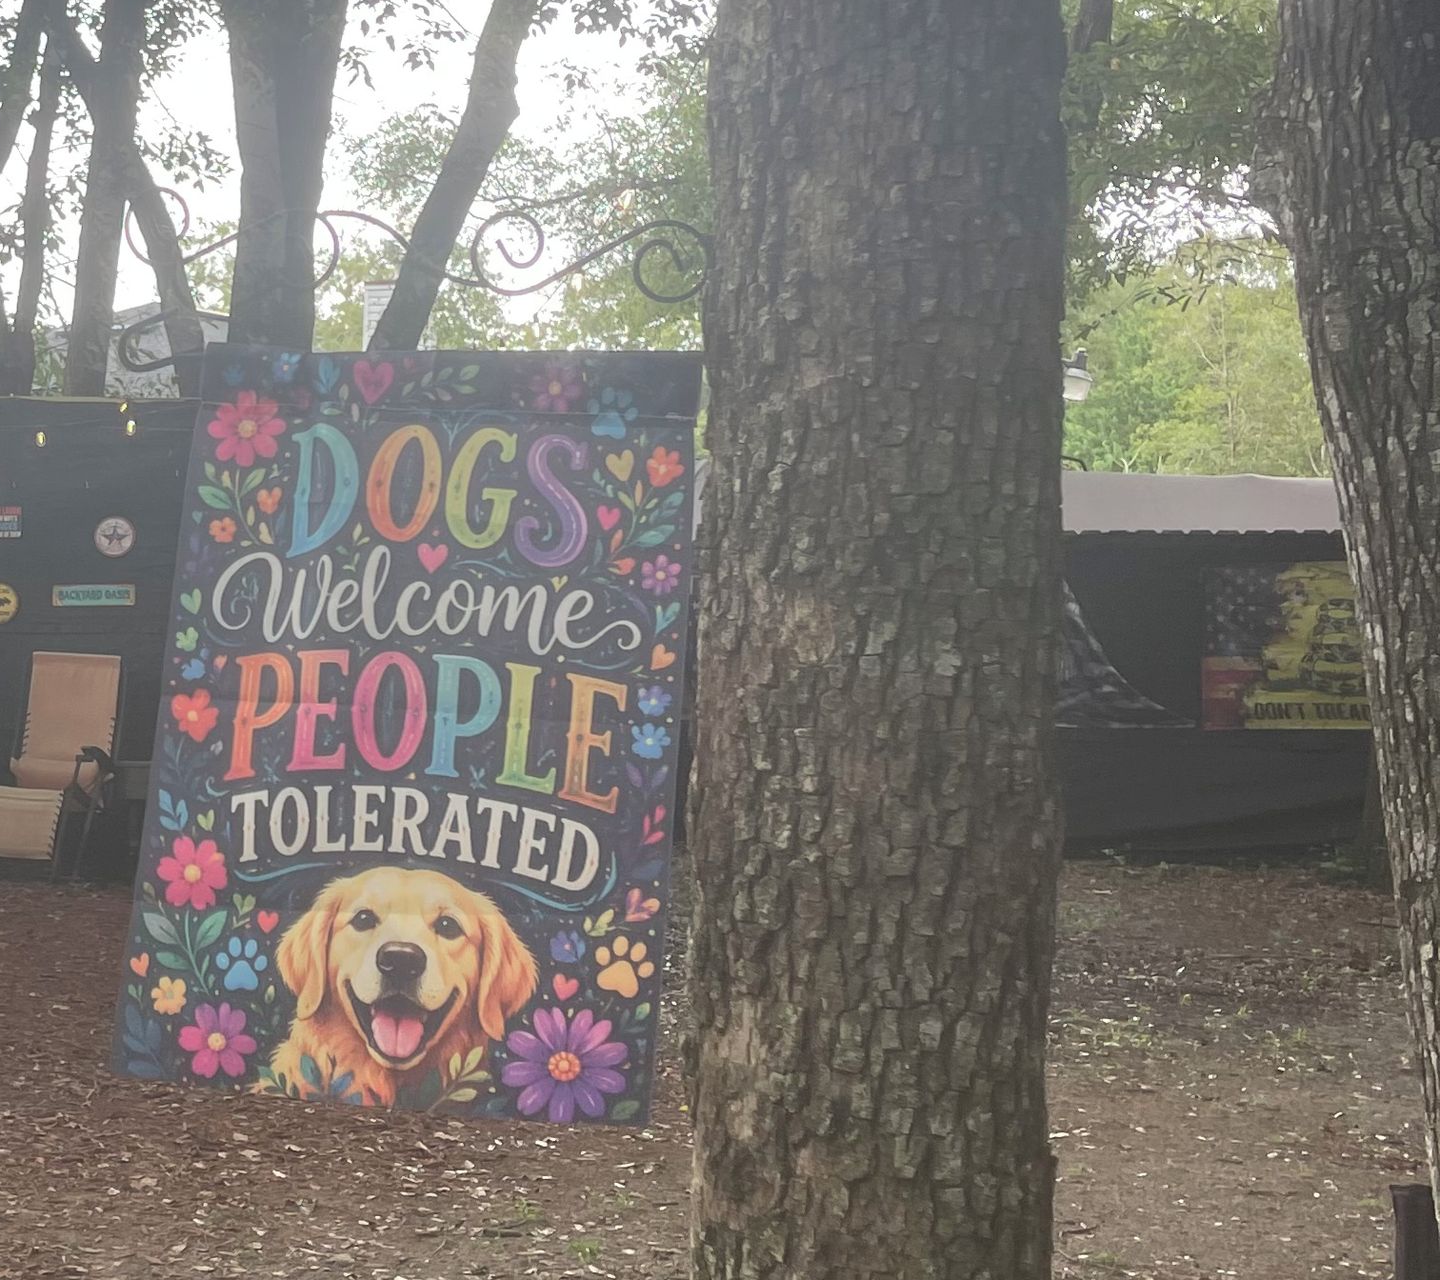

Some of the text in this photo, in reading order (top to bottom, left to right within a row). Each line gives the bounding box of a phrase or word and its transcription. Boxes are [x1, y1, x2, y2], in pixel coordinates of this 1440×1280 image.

[285, 422, 589, 569] DOGS
[58, 588, 130, 601] BACKYARD OASIS
[212, 544, 642, 656] Welcome
[223, 648, 628, 813] PEOPLE
[231, 786, 601, 892] TOLERATED
